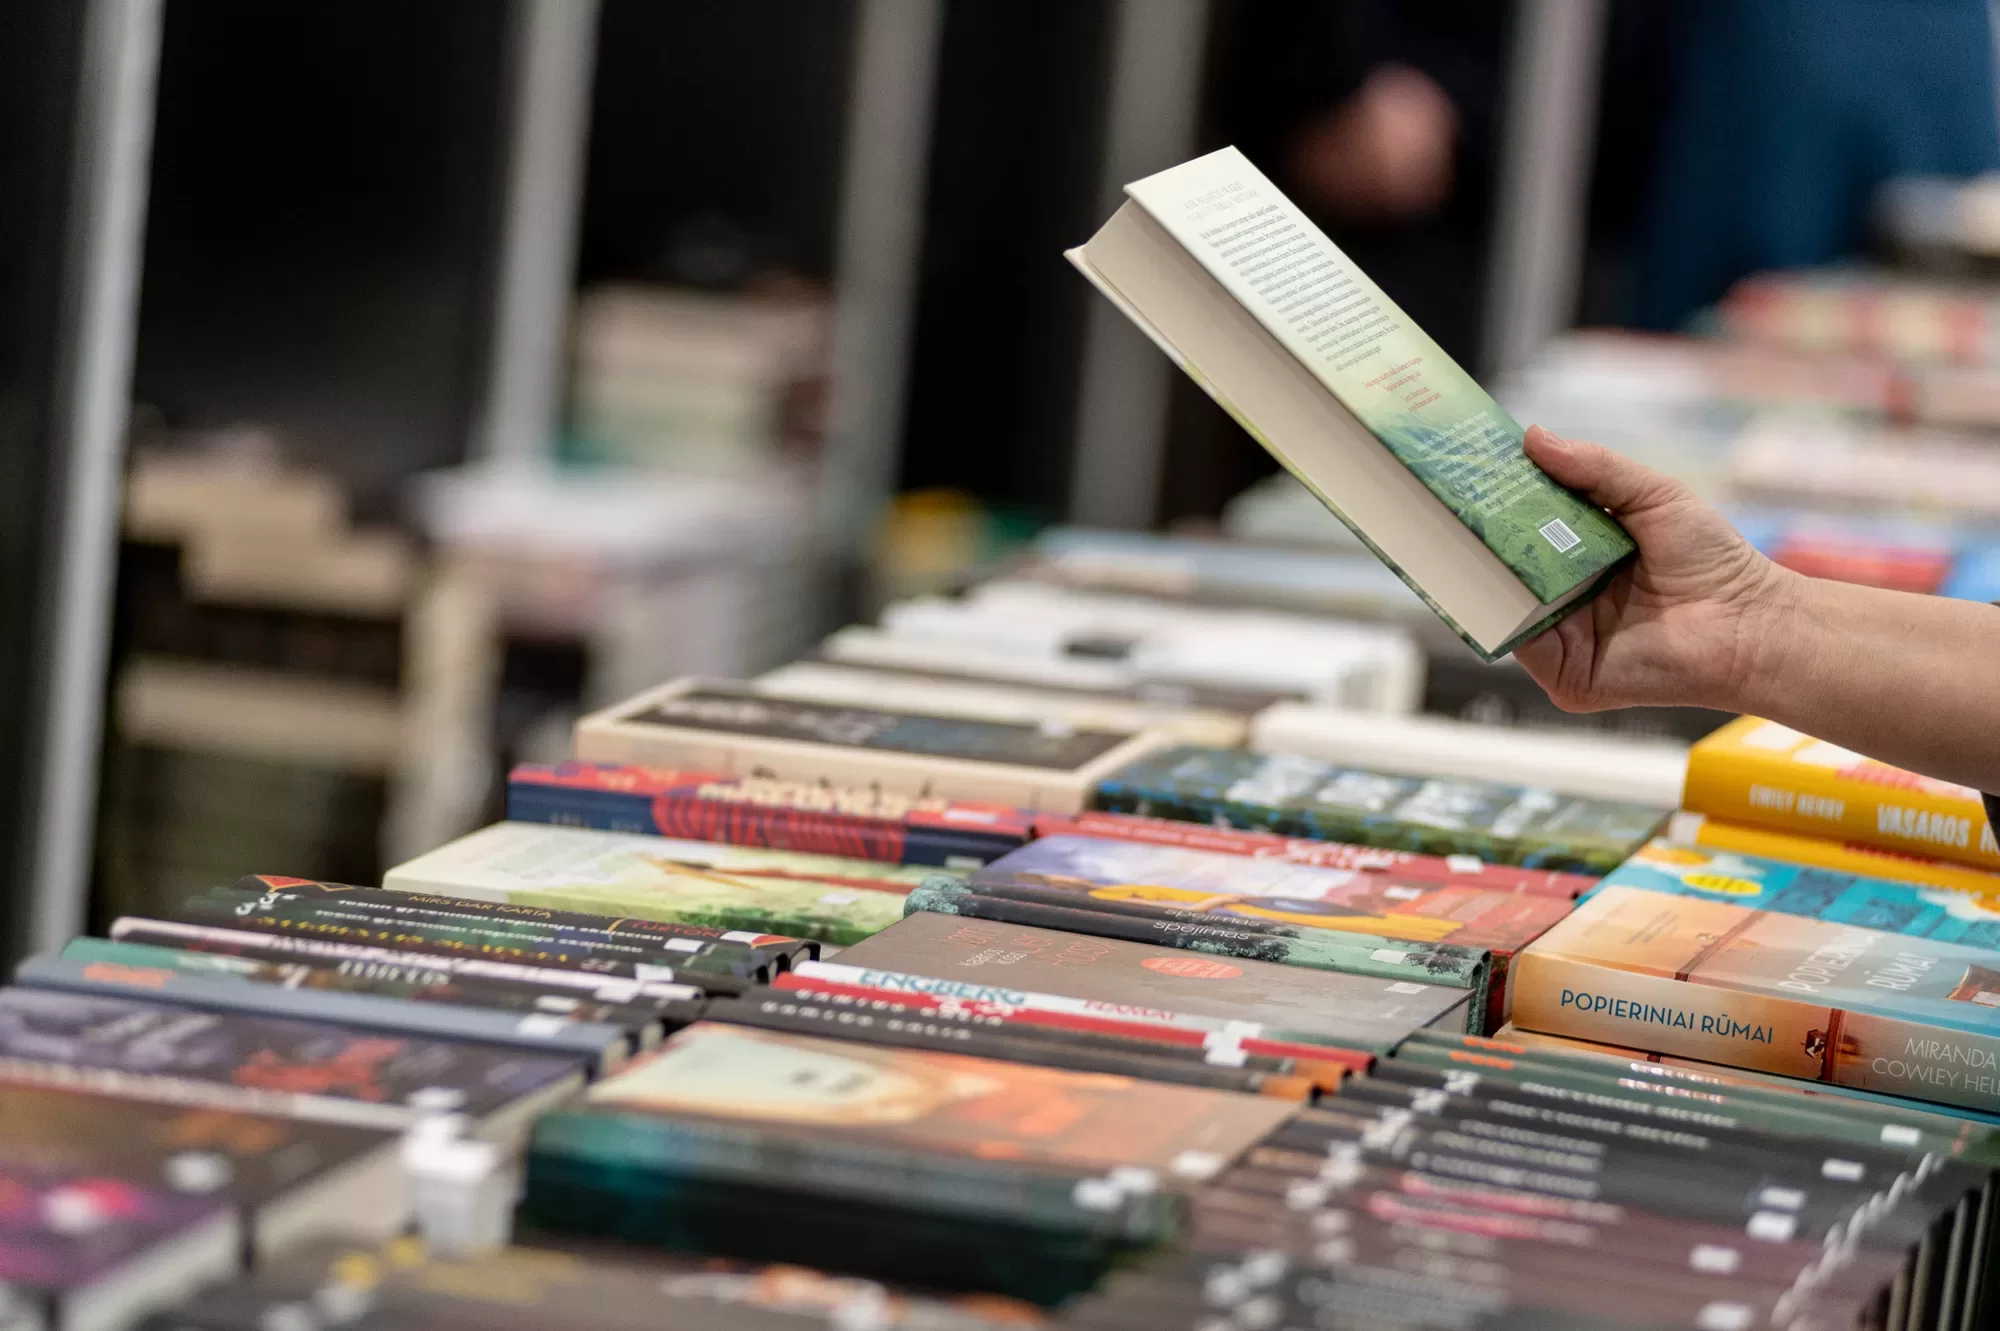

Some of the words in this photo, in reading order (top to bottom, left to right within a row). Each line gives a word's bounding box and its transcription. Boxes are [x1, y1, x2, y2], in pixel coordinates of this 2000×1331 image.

[1877, 803, 1971, 847] VASAROS
[858, 969, 1028, 1006] ENGBERG
[1560, 989, 1695, 1030] POPIERINIAI
[1700, 1013, 1773, 1044] RŪMAI
[1872, 1057, 1959, 1088] COWLEY
[1903, 1037, 1997, 1071] MIRANDA
